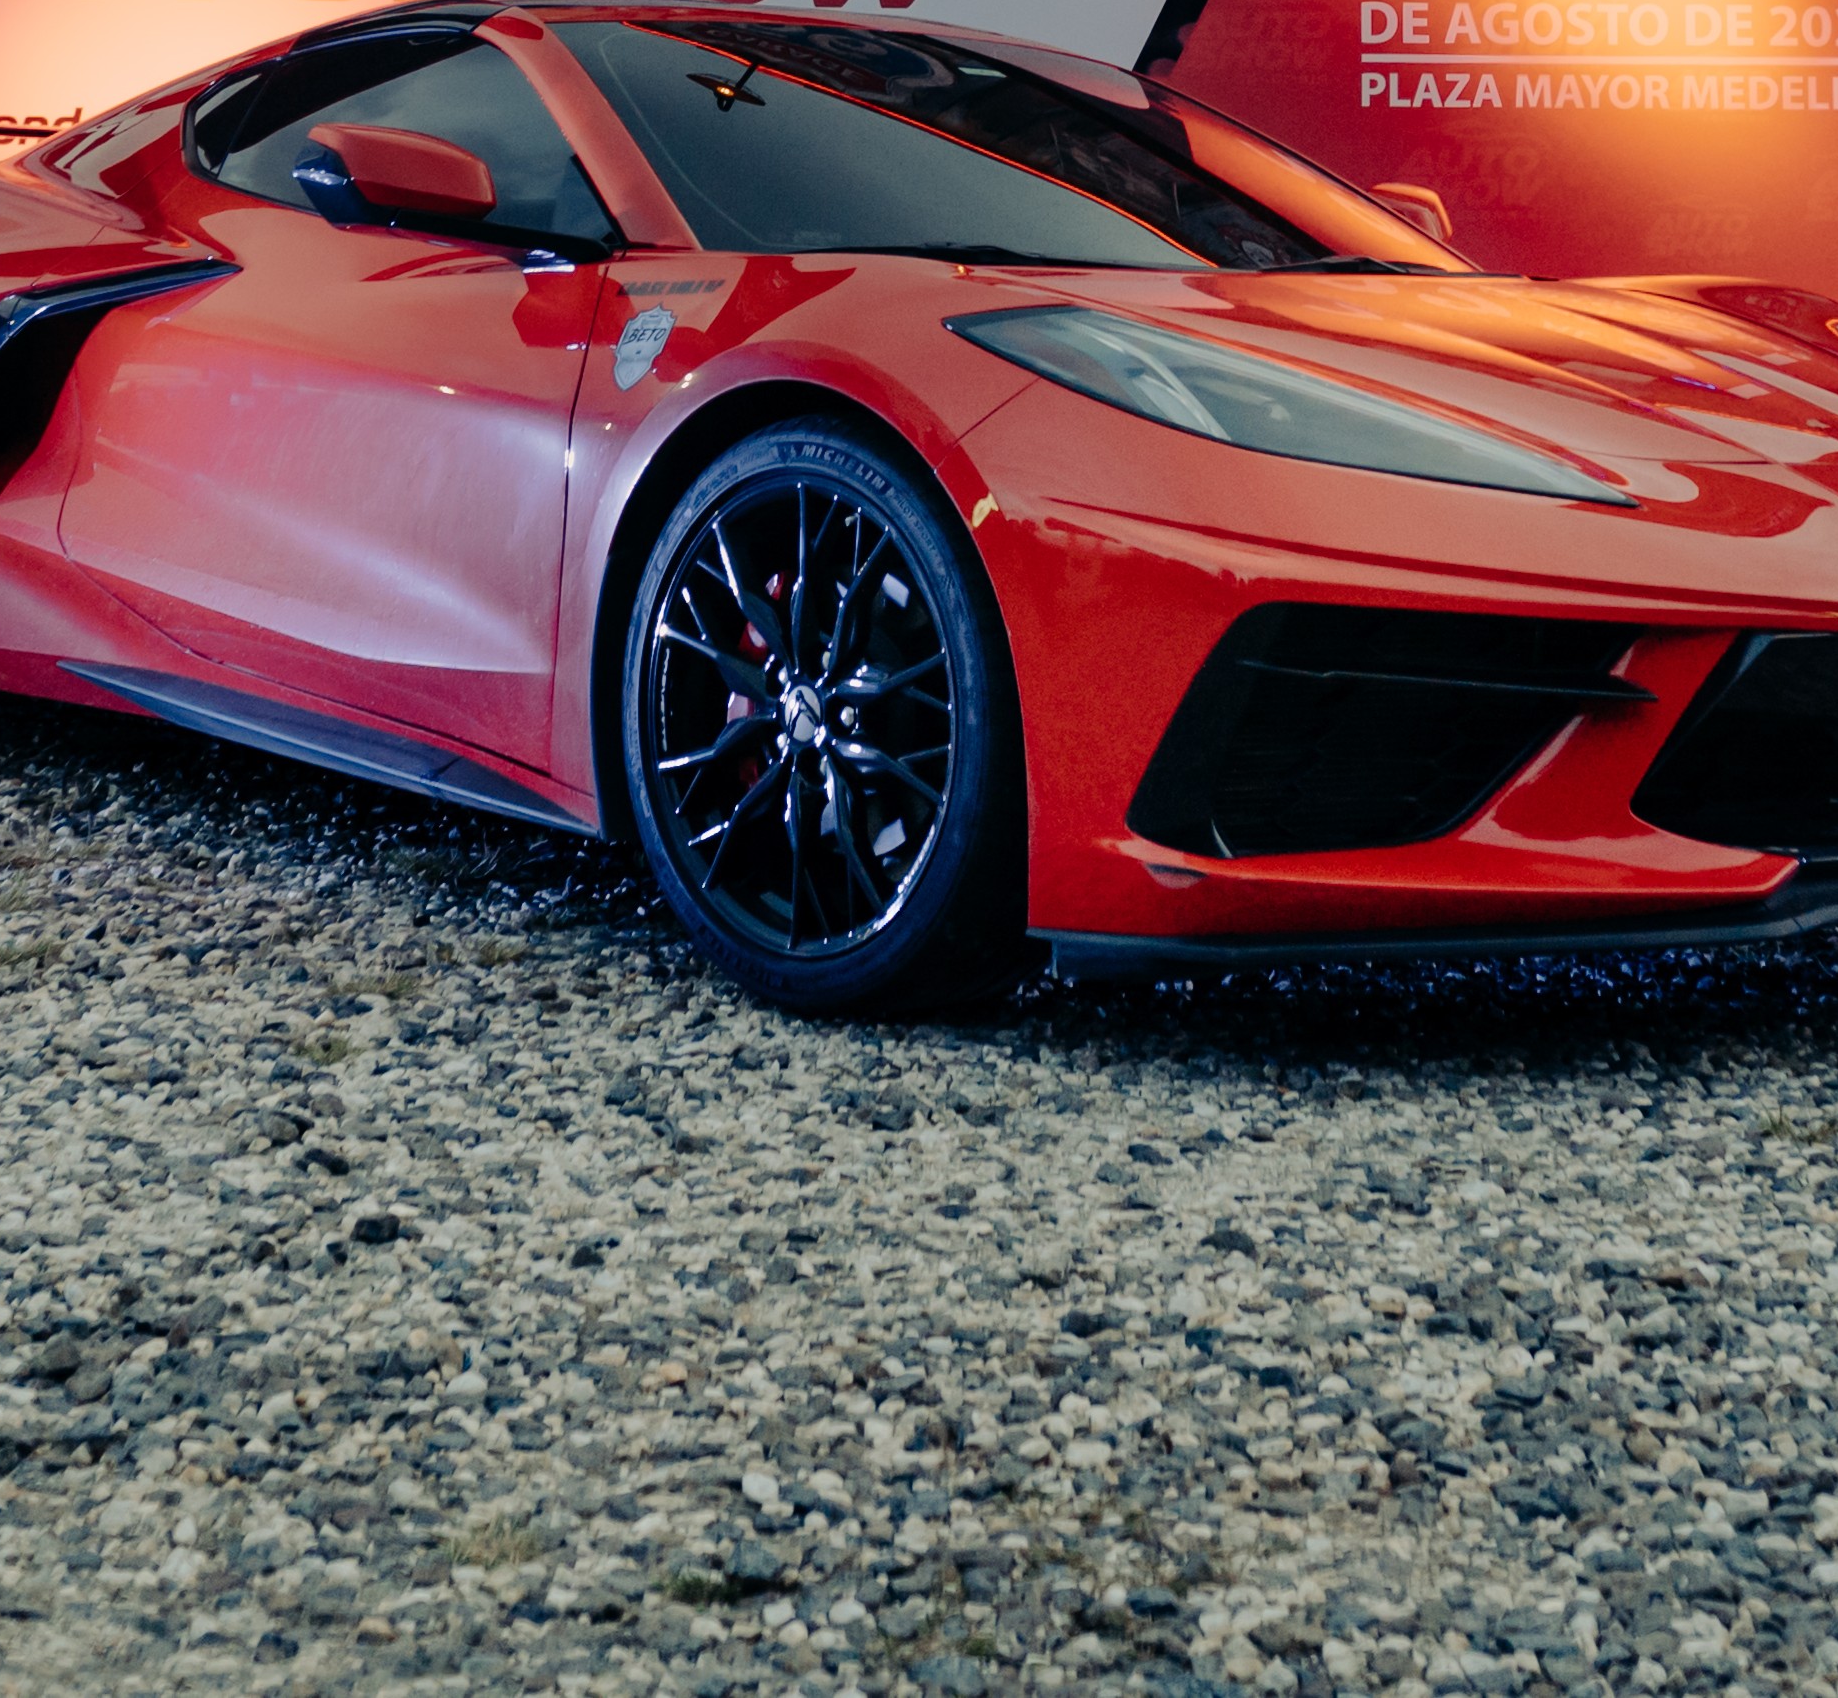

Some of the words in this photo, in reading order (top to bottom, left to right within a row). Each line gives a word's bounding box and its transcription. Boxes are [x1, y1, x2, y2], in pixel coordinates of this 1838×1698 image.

[1361, 3, 1429, 44] DE
[1445, 3, 1669, 47] AGOSTO
[1685, 4, 1754, 46] DE
[1361, 73, 1503, 108] PLAZA
[1514, 74, 1671, 110] MAYOR
[800, 444, 886, 491] MICHELIN
